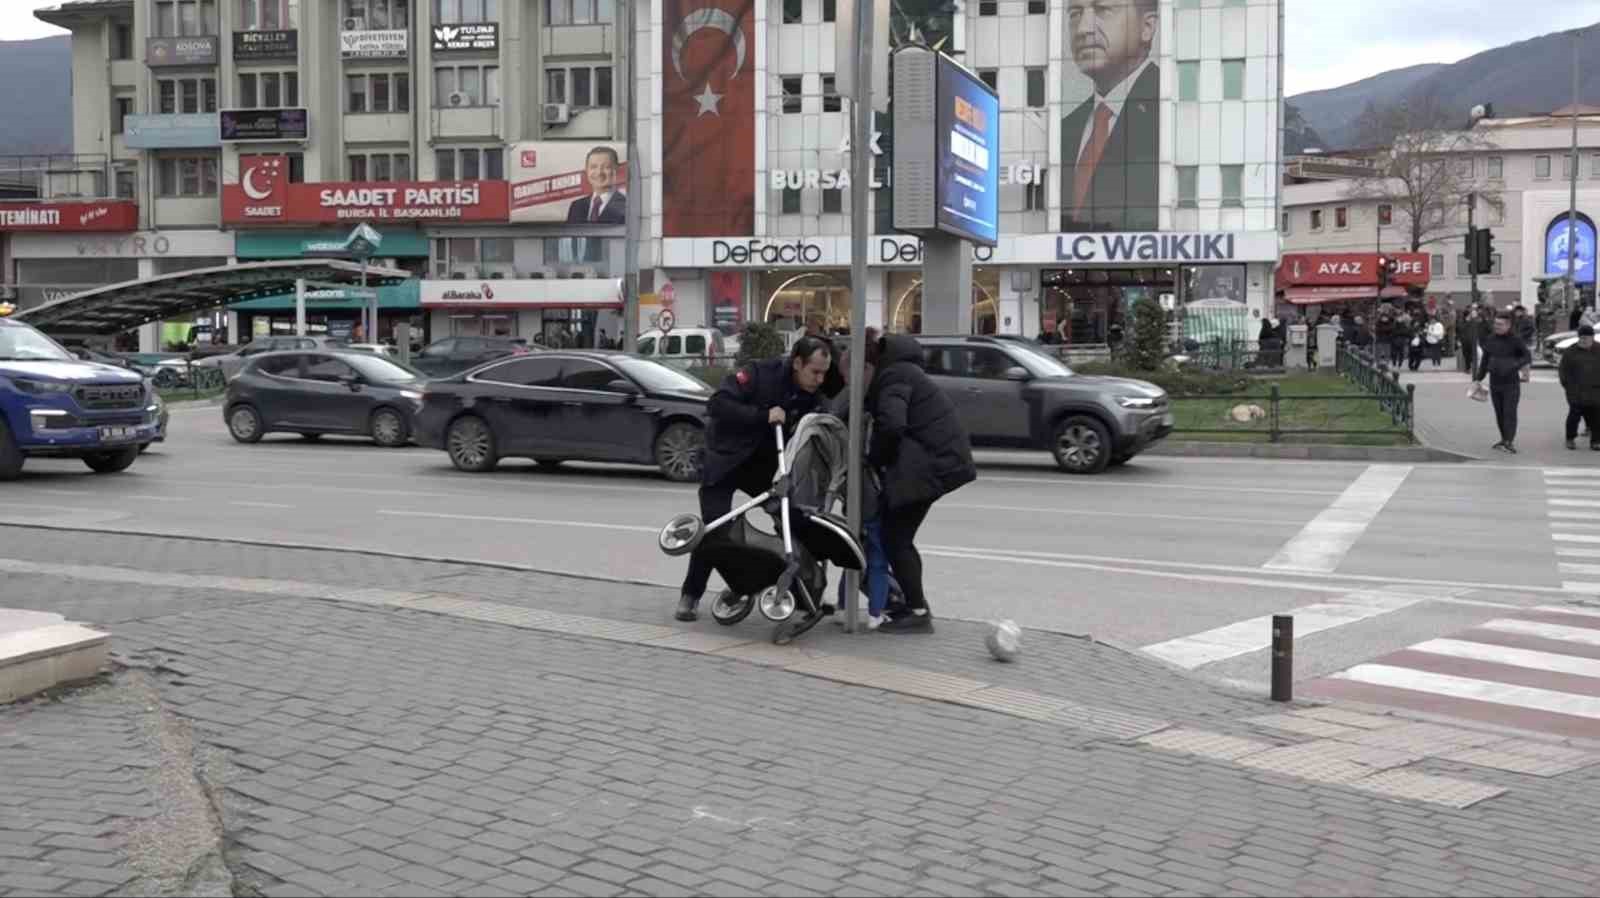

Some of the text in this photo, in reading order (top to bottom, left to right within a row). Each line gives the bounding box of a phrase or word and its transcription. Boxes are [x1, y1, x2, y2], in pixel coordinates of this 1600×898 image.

[771, 168, 851, 190] BURSA
[320, 183, 479, 206] SAADET PARTİSİ
[244, 206, 282, 216] SAADET
[337, 208, 375, 218] BURSA
[713, 240, 821, 264] DeFacto
[1055, 235, 1096, 260] LC
[1318, 262, 1361, 274] AYAZ
